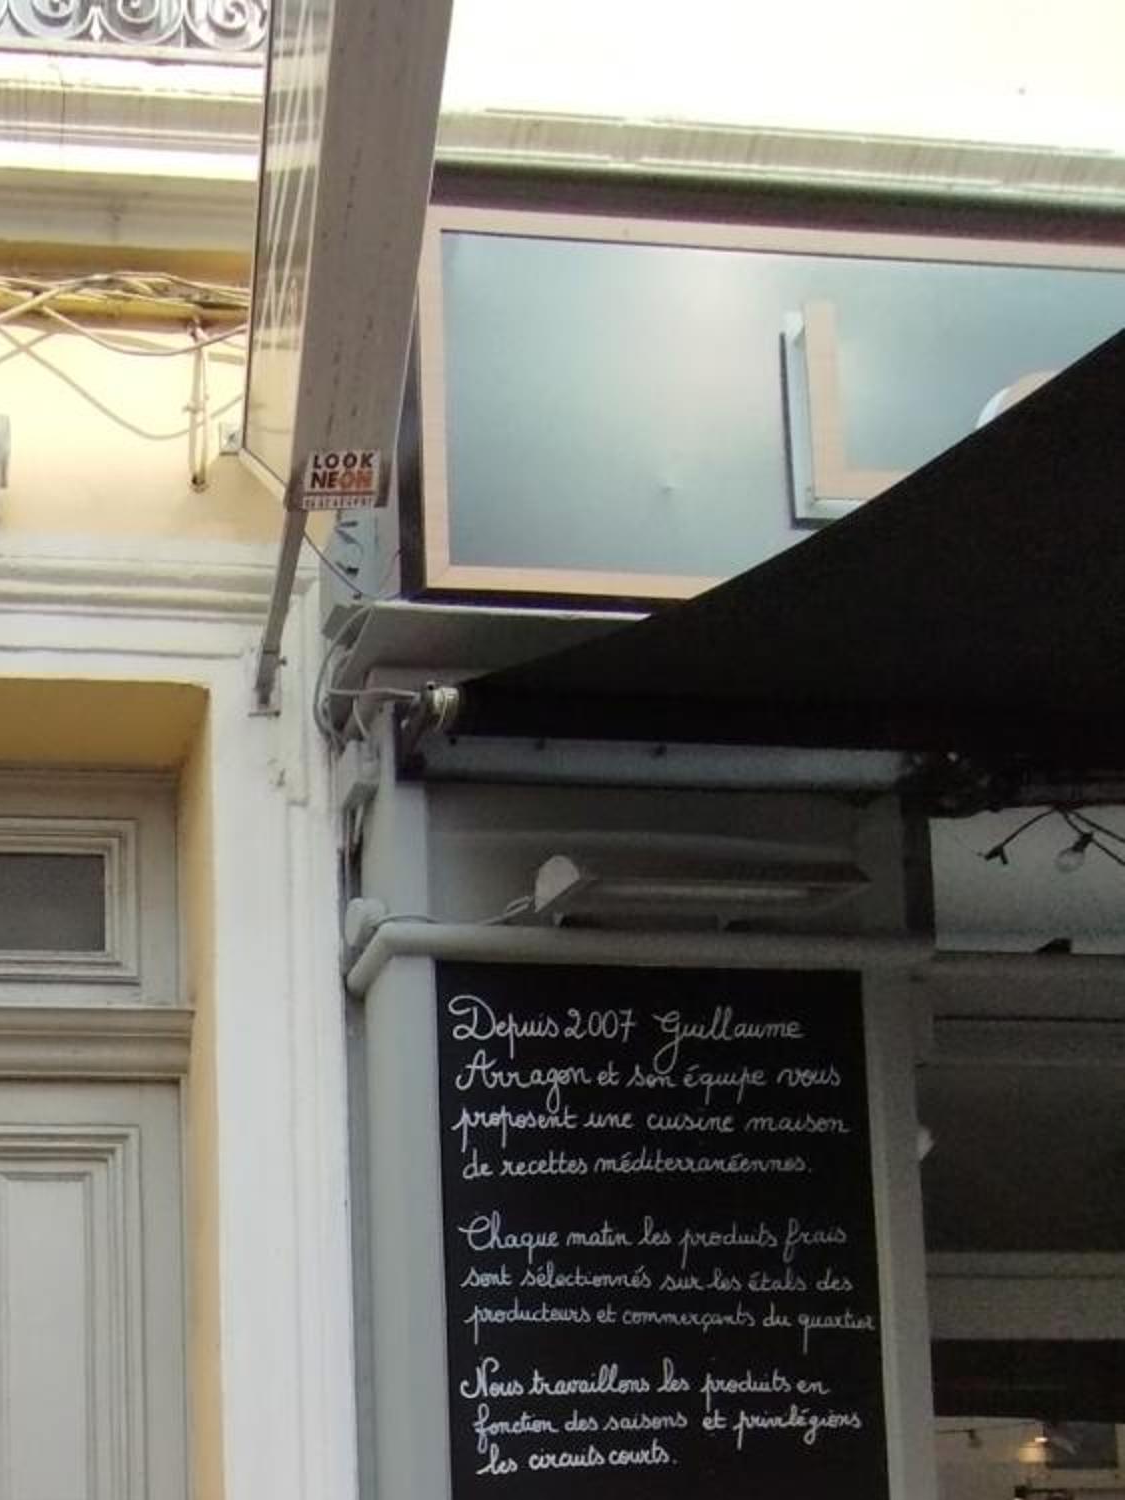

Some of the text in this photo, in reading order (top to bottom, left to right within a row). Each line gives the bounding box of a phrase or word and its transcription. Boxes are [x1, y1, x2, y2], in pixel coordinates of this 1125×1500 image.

[313, 452, 374, 469] LOOK
[448, 995, 806, 1075] Depuis 2007 Guillaume
[455, 1049, 842, 1115] Arragon et son équipe vous
[451, 1104, 852, 1153] proposent une cuisine maison
[462, 1147, 813, 1180] de recettes méditerranéennes.
[458, 1210, 848, 1270] Chaque matin les produits frais
[460, 1260, 854, 1292] sont sélectionnés sur les étals des
[463, 1296, 875, 1356] producteurs et commerçants du quartier
[460, 1357, 831, 1414] Nous travaillons les produits en
[473, 1403, 863, 1454] fonction des saisons et privilégions
[476, 1438, 678, 1476] les circuits courts.
